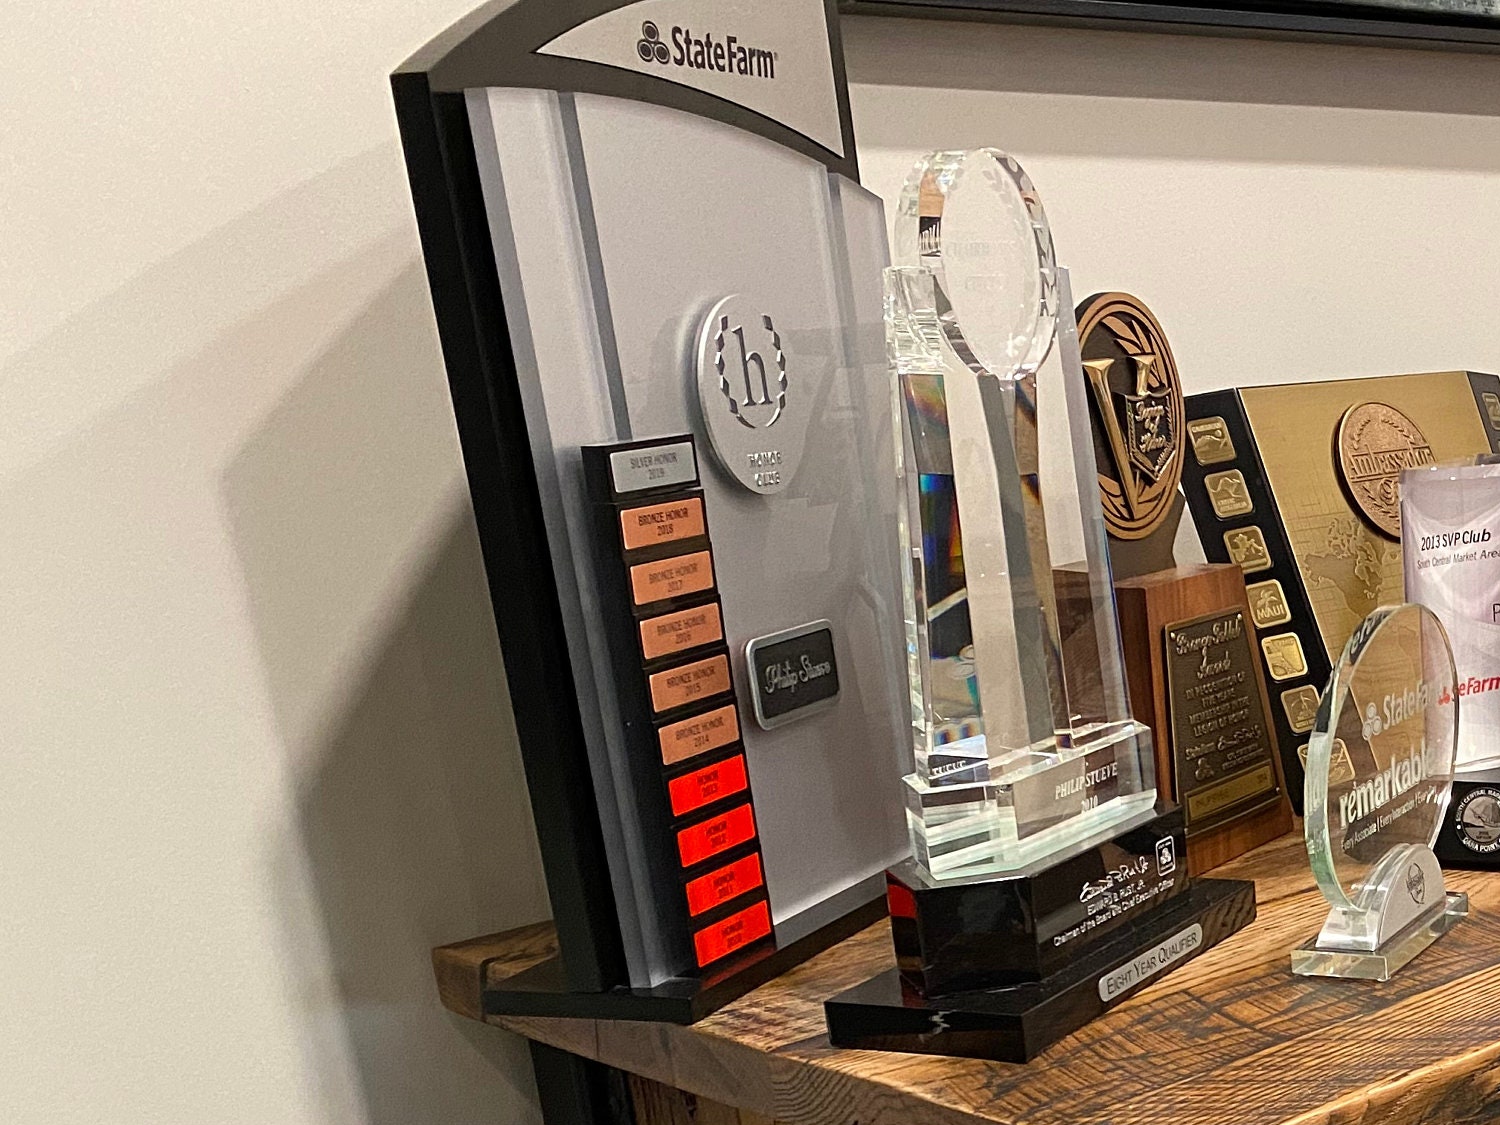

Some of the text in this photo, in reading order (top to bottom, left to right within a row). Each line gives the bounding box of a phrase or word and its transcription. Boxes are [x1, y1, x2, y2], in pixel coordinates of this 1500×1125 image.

[655, 452, 678, 465] HONOR
[638, 507, 689, 527] BRONZE HONOR
[1421, 528, 1492, 552] 2013 SVP Club
[1417, 559, 1431, 570] South
[1432, 555, 1452, 567] Central
[1453, 551, 1478, 564] Market
[1256, 604, 1286, 621] MAUI
[1055, 761, 1119, 800] PHILIP STUEVE
[1464, 789, 1487, 804] CENTRAL
[1053, 926, 1080, 946] Chairman
[1096, 910, 1112, 925] Board
[1133, 956, 1157, 977] YEAR
[1158, 931, 1198, 964] QUALIFIER
